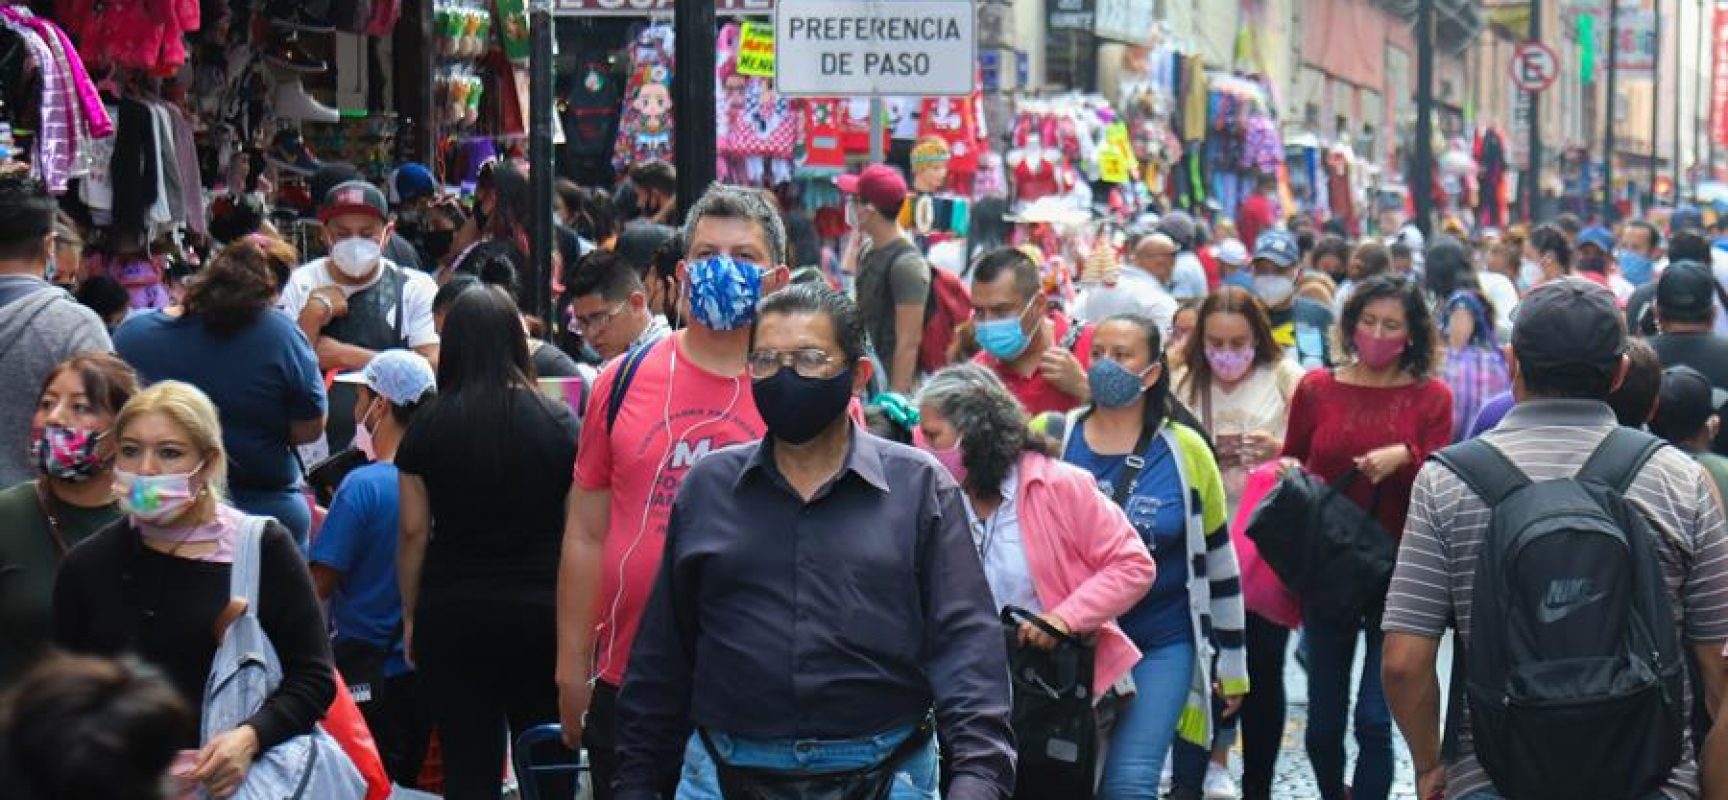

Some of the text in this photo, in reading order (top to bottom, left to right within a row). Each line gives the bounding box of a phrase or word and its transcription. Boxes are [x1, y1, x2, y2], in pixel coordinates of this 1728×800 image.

[789, 17, 961, 41] PREFERENCIA
[821, 53, 931, 76] DE PASO
